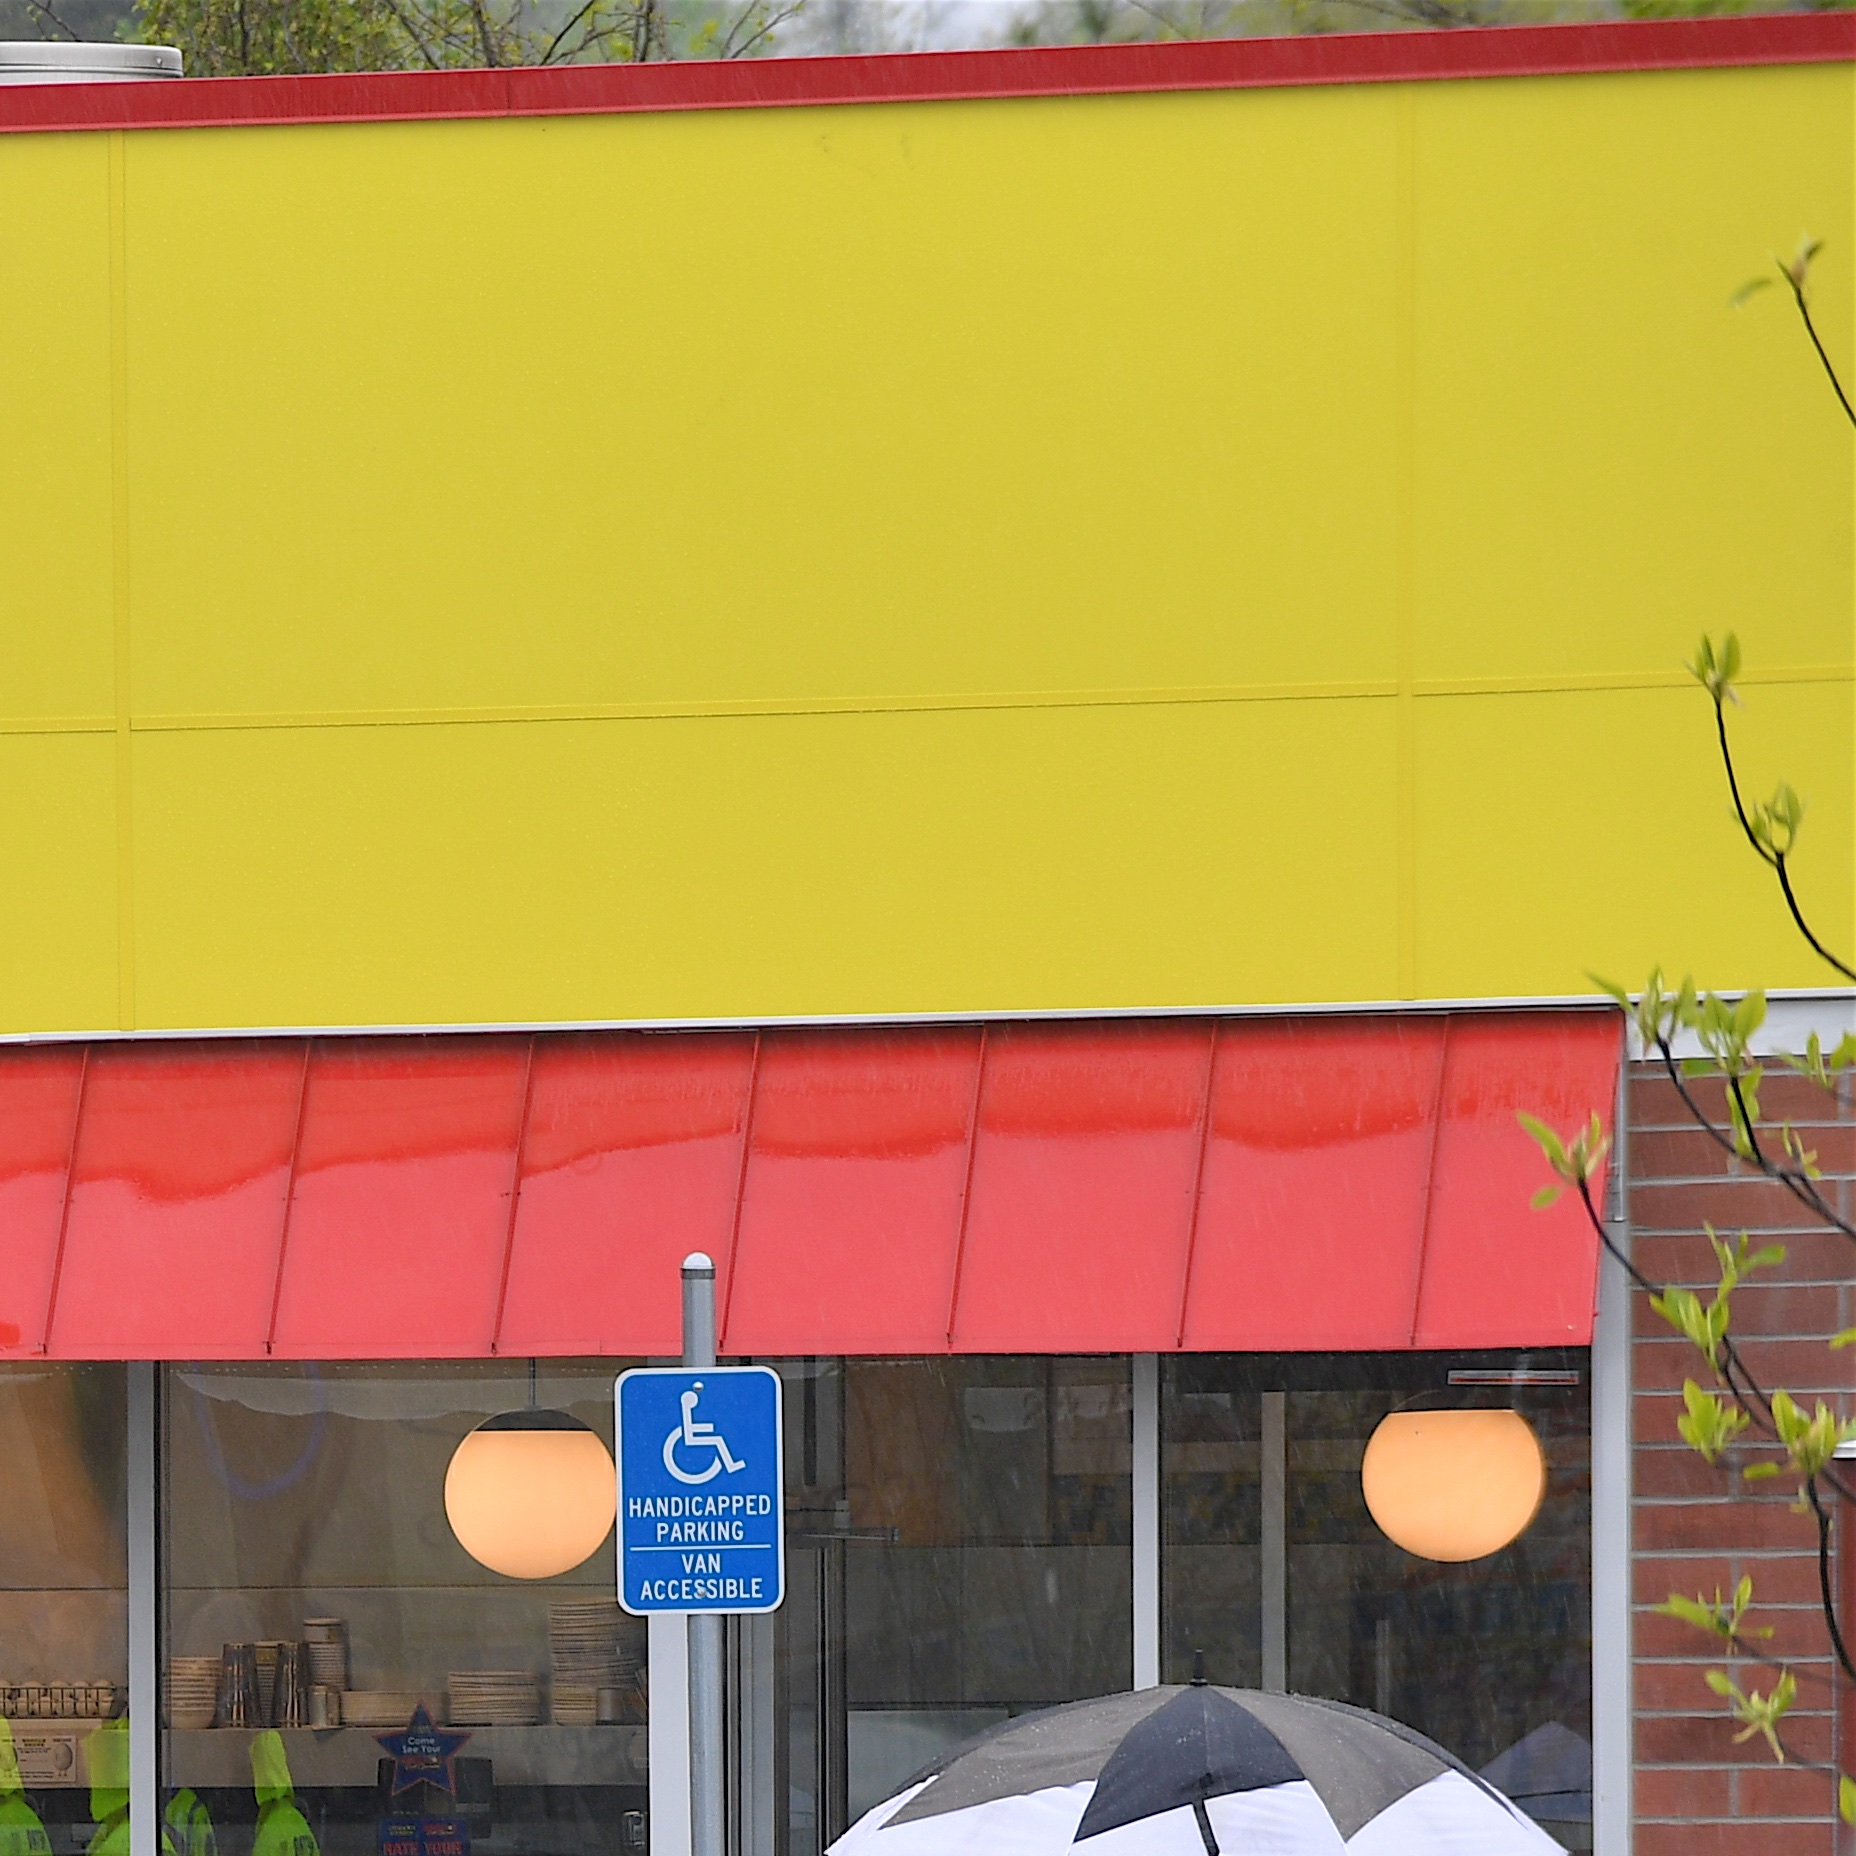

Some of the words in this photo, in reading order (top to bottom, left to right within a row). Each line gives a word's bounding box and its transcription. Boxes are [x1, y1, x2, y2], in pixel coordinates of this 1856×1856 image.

[629, 1495, 771, 1518] HANDICAPPED
[657, 1521, 744, 1543] PARKING
[681, 1553, 721, 1574] VAN
[640, 1578, 763, 1600] ACCESSIBLE
